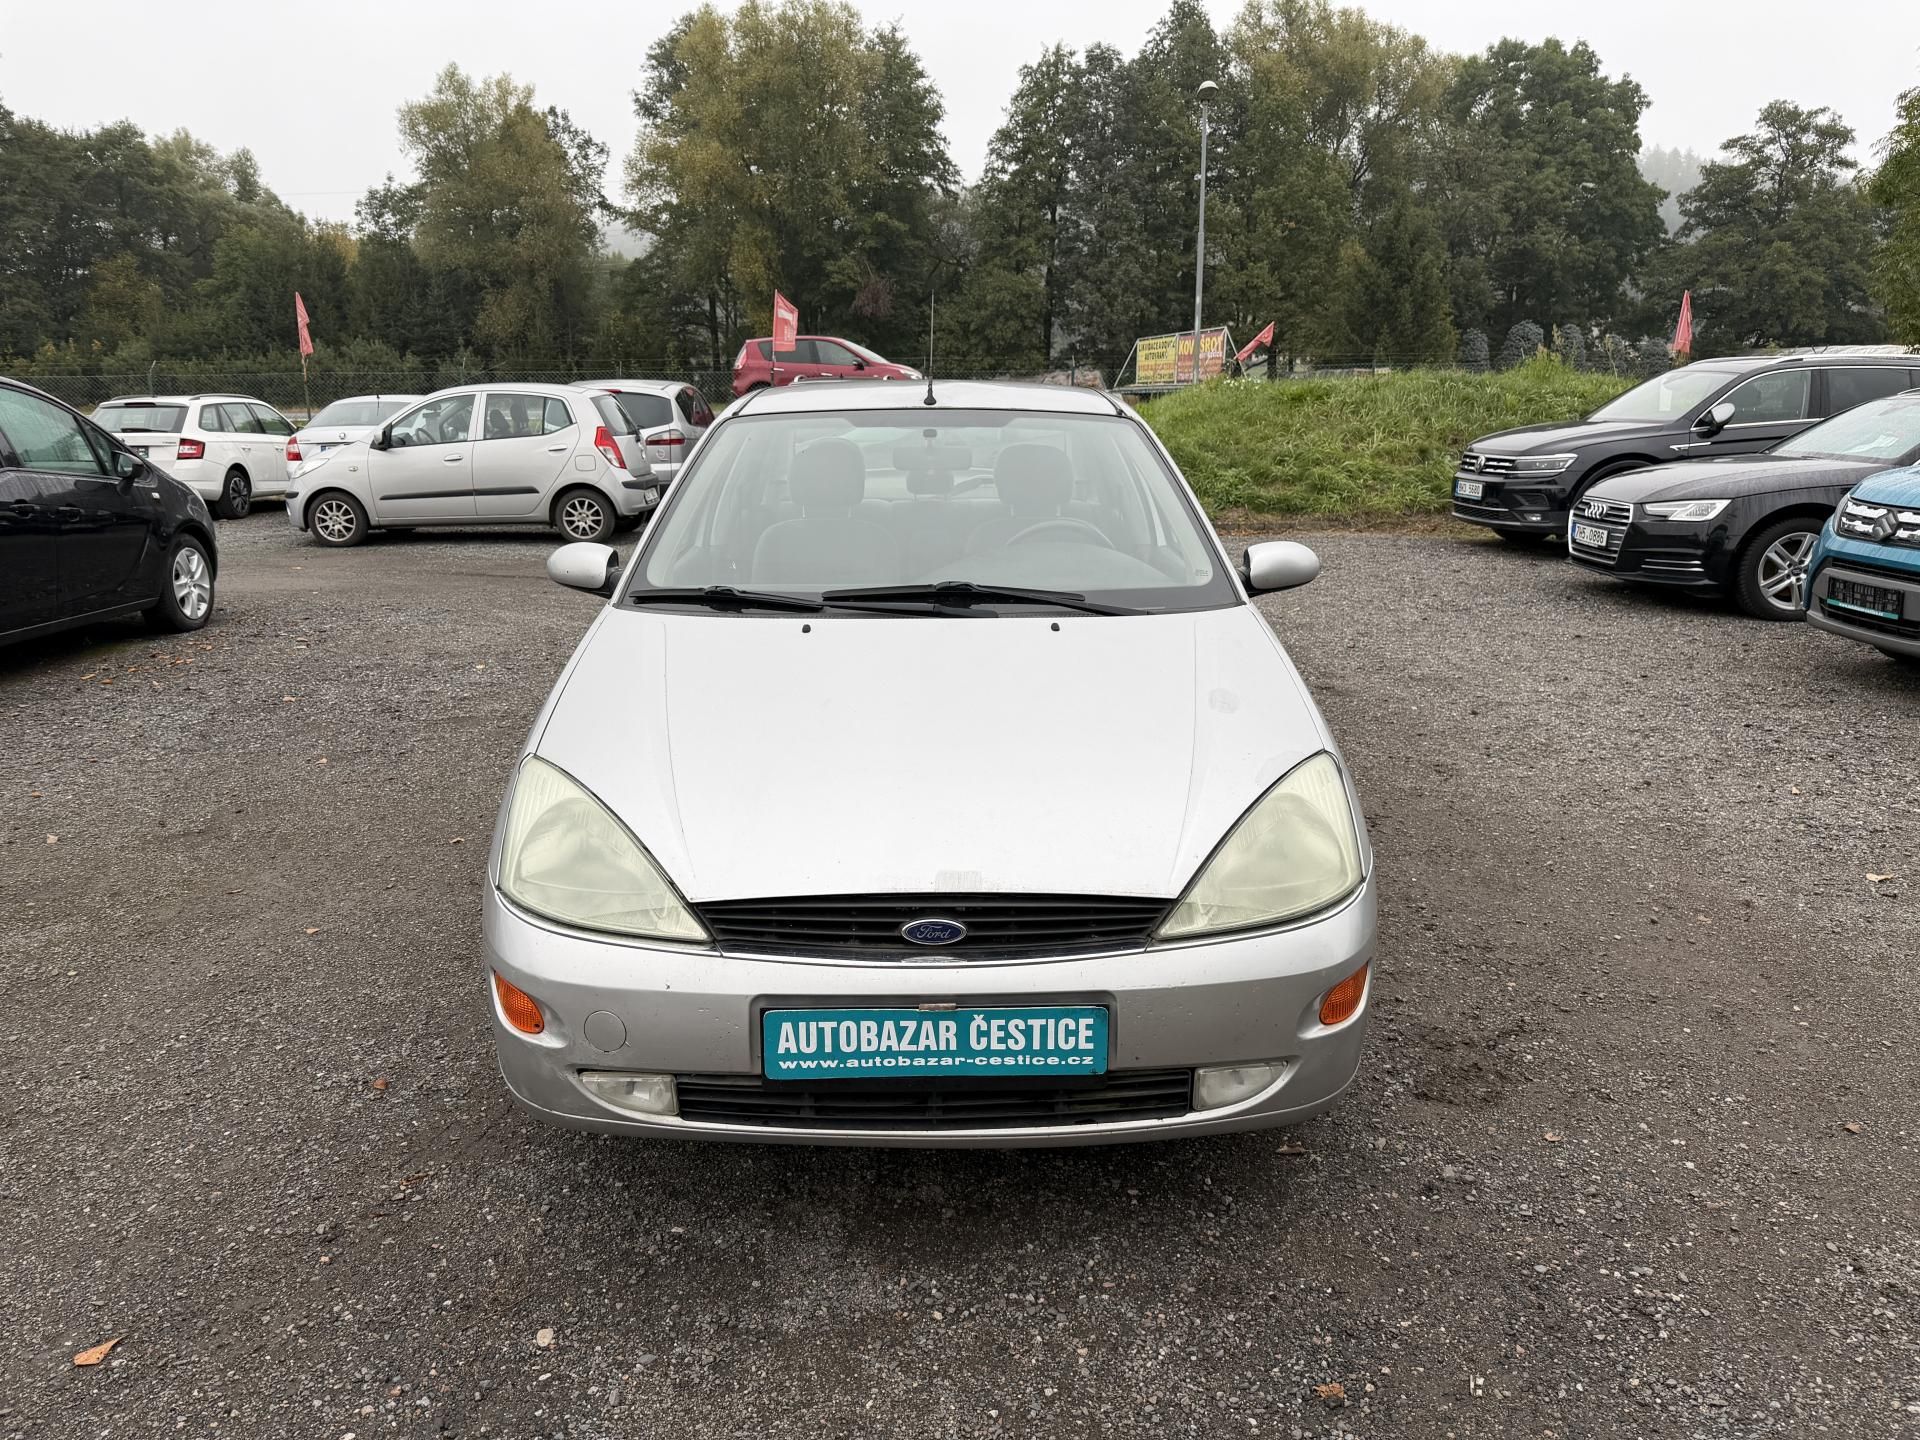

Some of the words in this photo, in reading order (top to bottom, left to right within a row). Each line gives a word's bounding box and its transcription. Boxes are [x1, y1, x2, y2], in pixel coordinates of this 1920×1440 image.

[1179, 335, 1223, 355] KOVŠROT
[916, 924, 951, 939] Ford
[777, 1020, 957, 1054] AUTOBAZAR
[969, 1015, 1094, 1051] ČESTICE
[778, 1054, 1094, 1069] www.autobazar-cestice.cz
